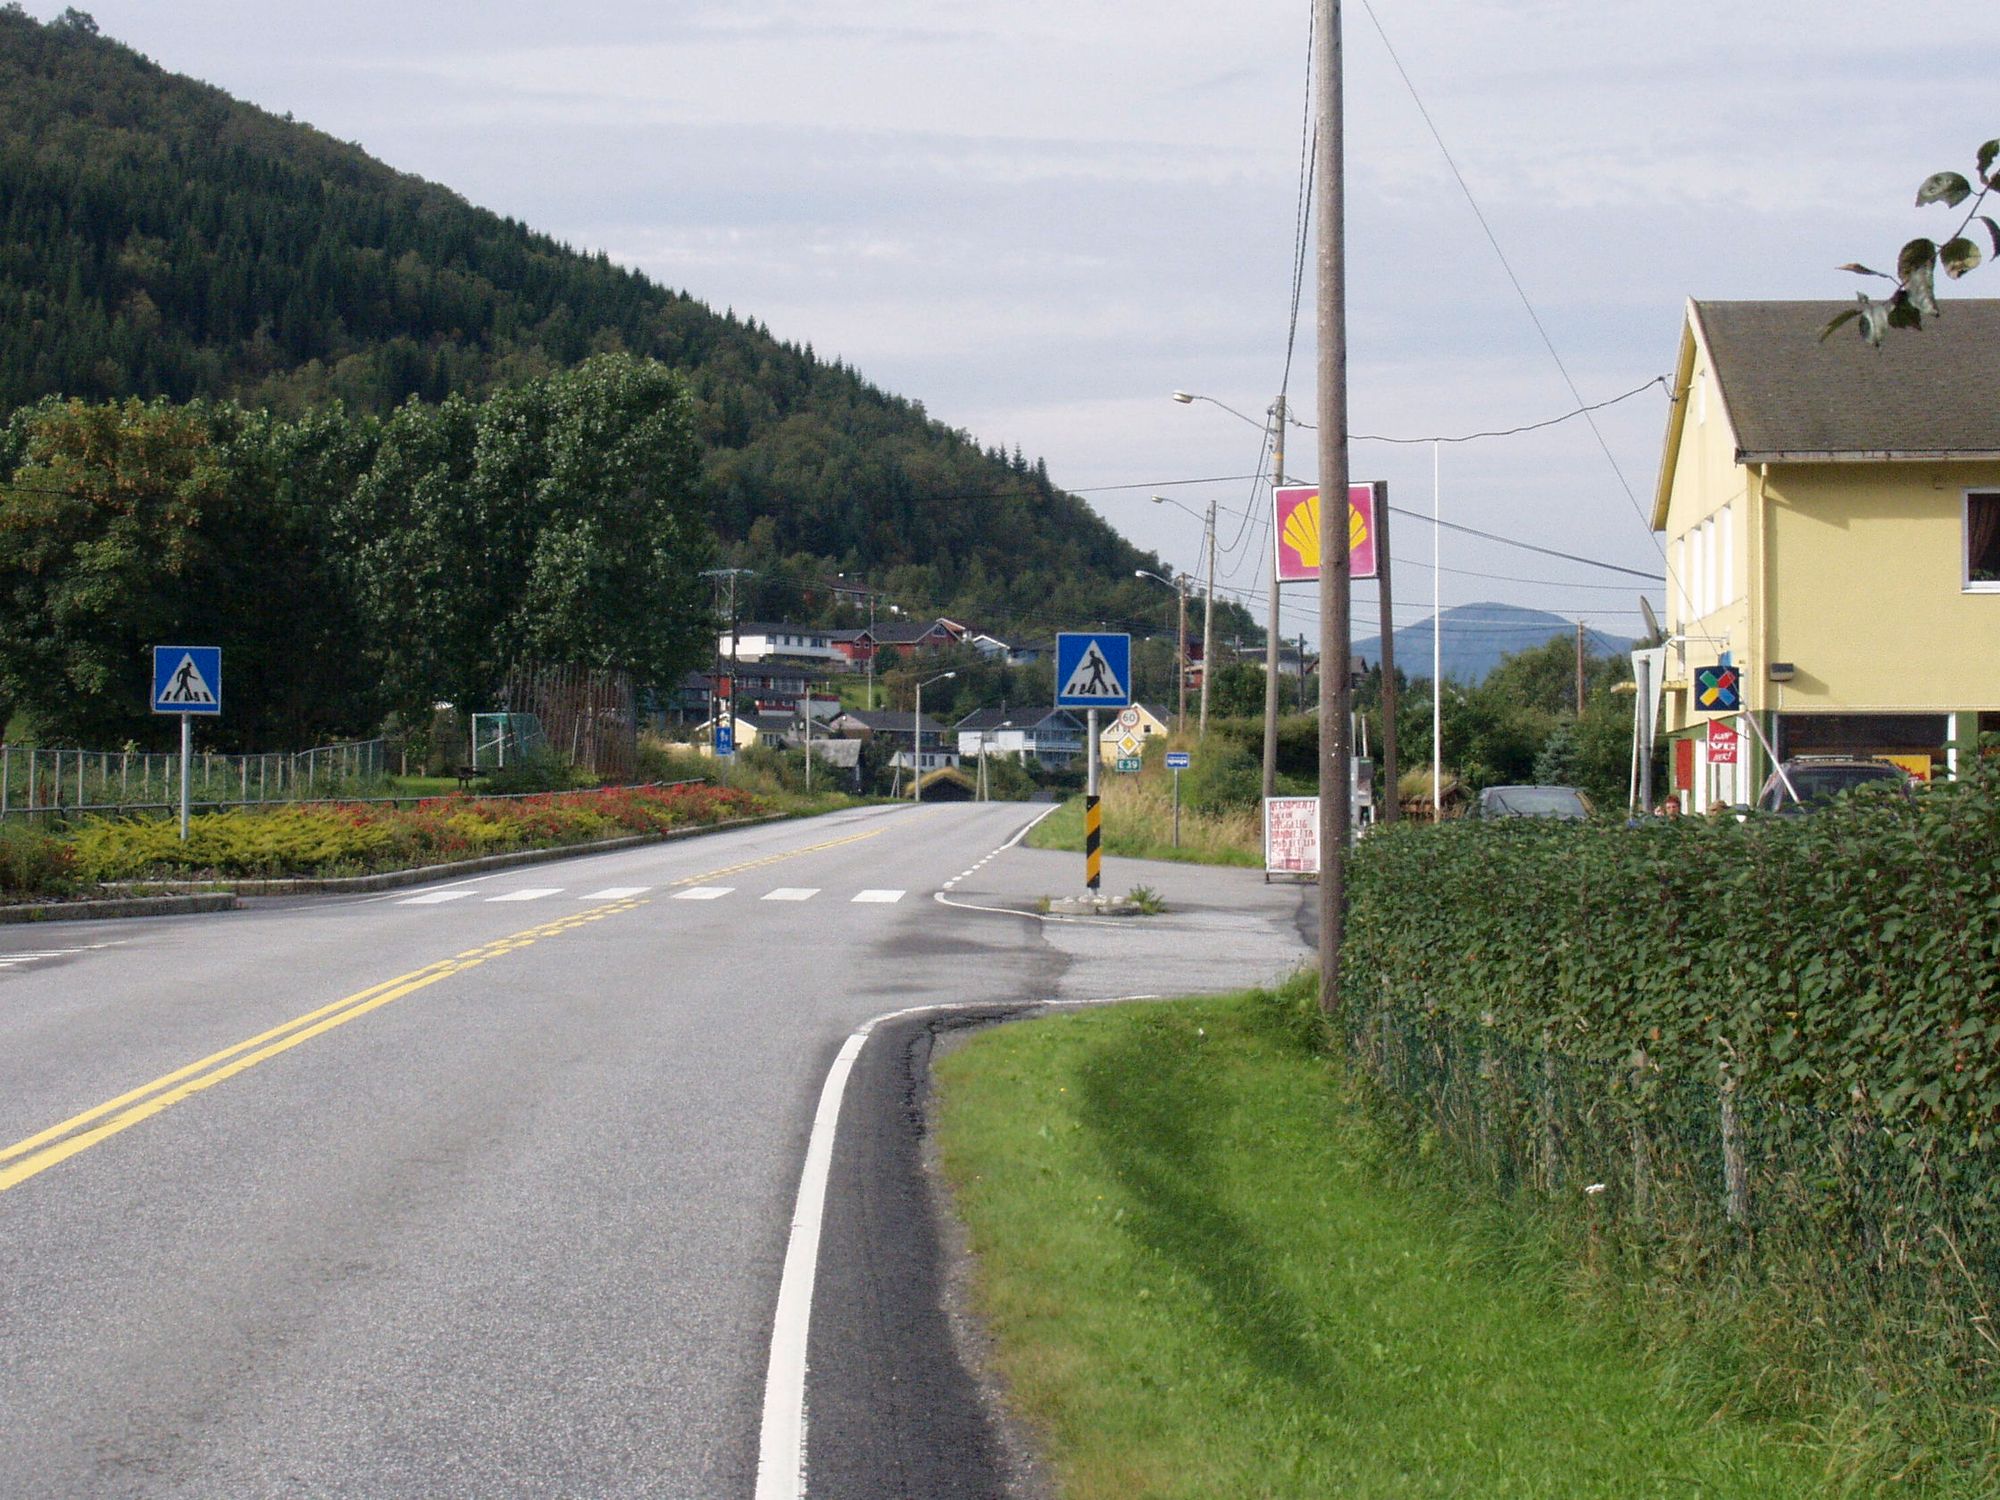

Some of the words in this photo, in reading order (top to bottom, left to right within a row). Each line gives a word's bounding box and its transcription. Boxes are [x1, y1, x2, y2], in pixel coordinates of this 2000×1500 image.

[1122, 713, 1136, 723] 60
[1119, 760, 1125, 769] E
[1128, 760, 1138, 769] 39
